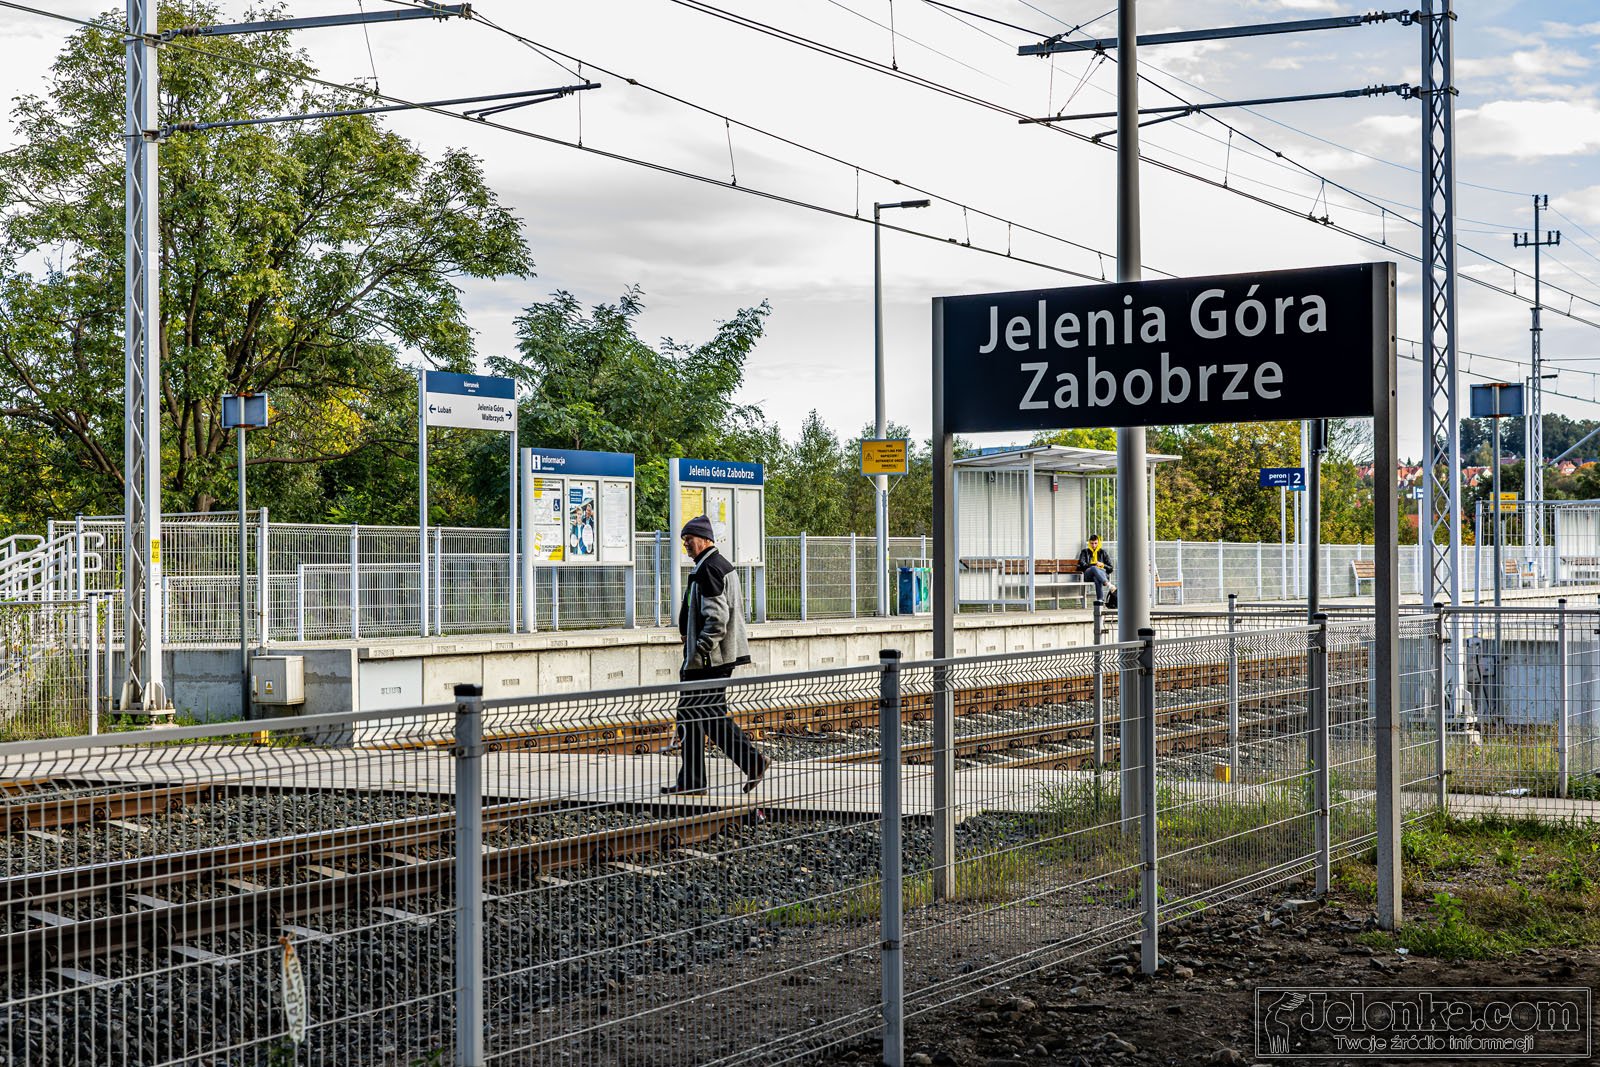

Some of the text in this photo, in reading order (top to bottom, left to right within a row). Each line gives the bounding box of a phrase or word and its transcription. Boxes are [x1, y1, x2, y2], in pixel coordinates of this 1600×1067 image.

[978, 284, 1328, 354] Jelenia Góra
[1019, 351, 1284, 410] Zabobrze
[437, 406, 452, 414] Lubań
[477, 404, 504, 412] Jelenia Góra
[482, 414, 504, 423] Wałbrzych
[541, 455, 566, 466] informacja
[689, 465, 755, 479] Jelenia Góra Zabobrze
[1293, 473, 1301, 484] 2
